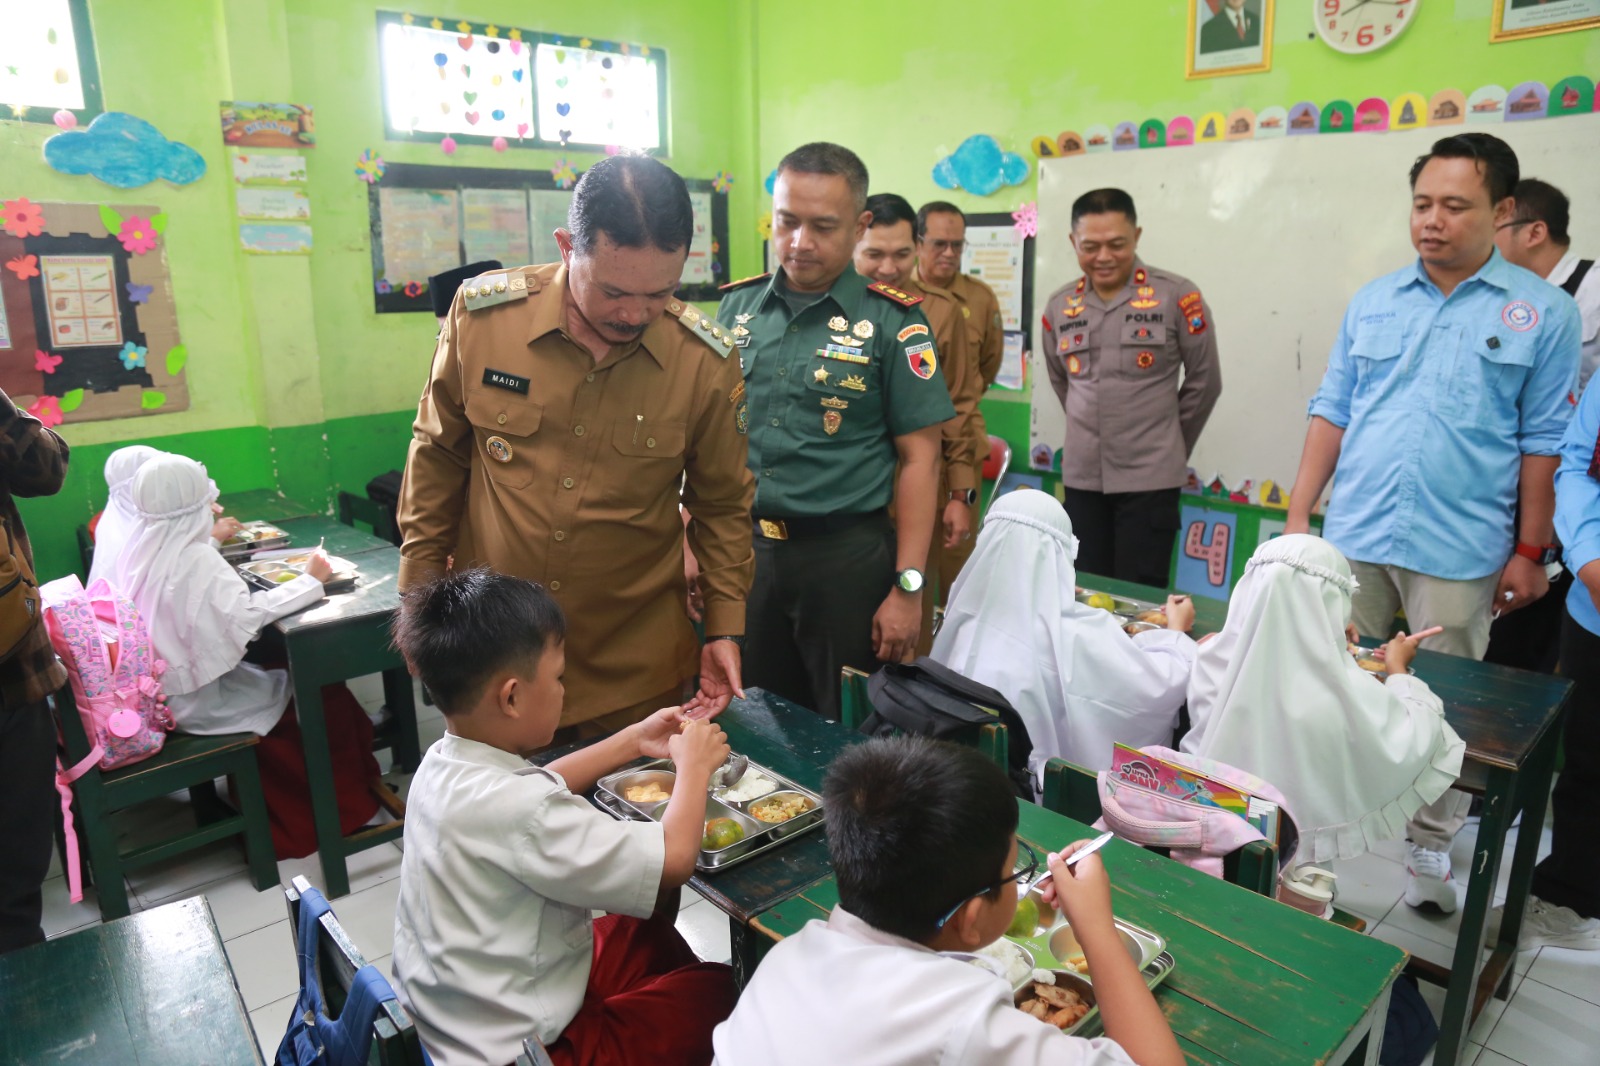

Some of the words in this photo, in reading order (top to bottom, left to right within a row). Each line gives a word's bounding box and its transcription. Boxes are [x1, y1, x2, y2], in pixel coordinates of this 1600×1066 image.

[1324, 0, 1340, 17] 9
[1341, 31, 1349, 42] 7
[1356, 24, 1374, 47] 6
[1384, 24, 1392, 36] 5
[1125, 313, 1163, 323] POLRI
[492, 374, 519, 387] MAIDI
[1185, 521, 1230, 587] 4
